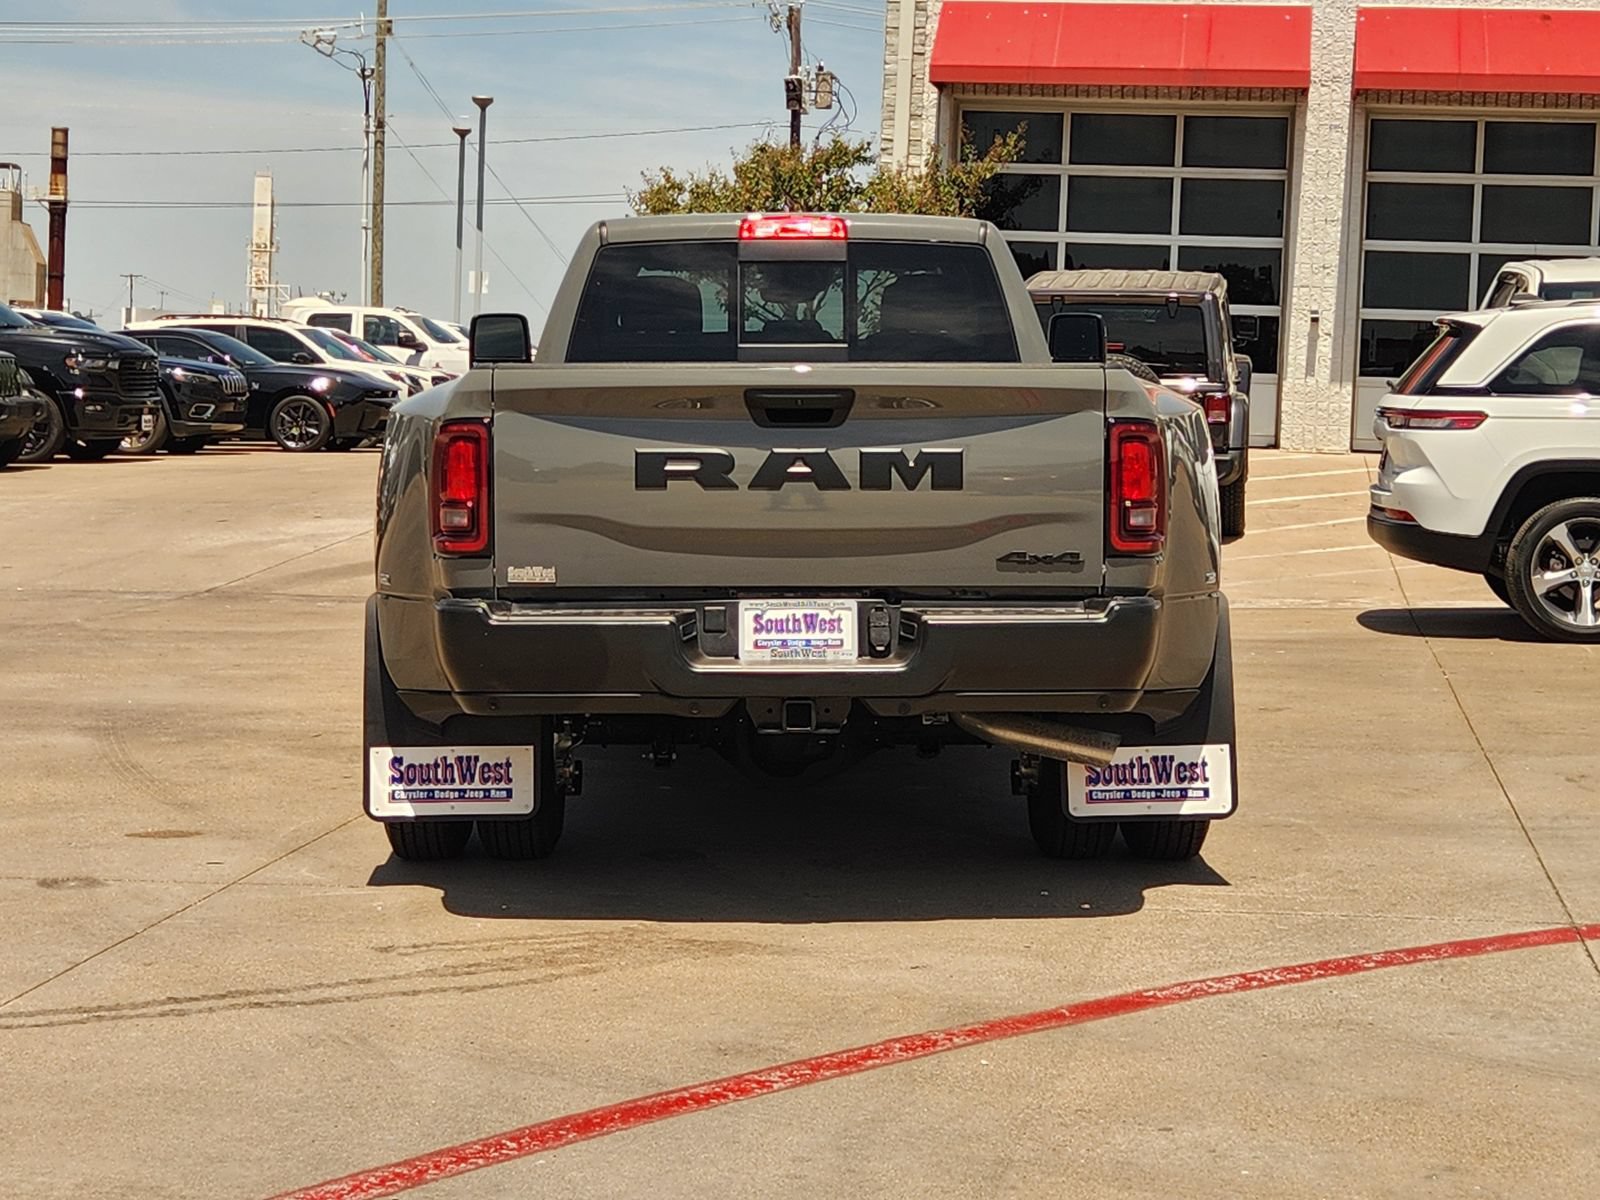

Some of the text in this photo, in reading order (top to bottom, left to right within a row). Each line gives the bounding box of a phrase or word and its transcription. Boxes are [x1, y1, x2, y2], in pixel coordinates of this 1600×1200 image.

[635, 448, 963, 490] RAM
[753, 613, 843, 635] SouthWest
[770, 648, 827, 658] SouthWest
[389, 755, 513, 786] SouthWest
[394, 789, 507, 799] Chrysler Dodge Jeep Ram
[1092, 790, 1125, 799] Chrysler
[1131, 790, 1156, 799] Dodge
[1161, 789, 1181, 798] Jeep
